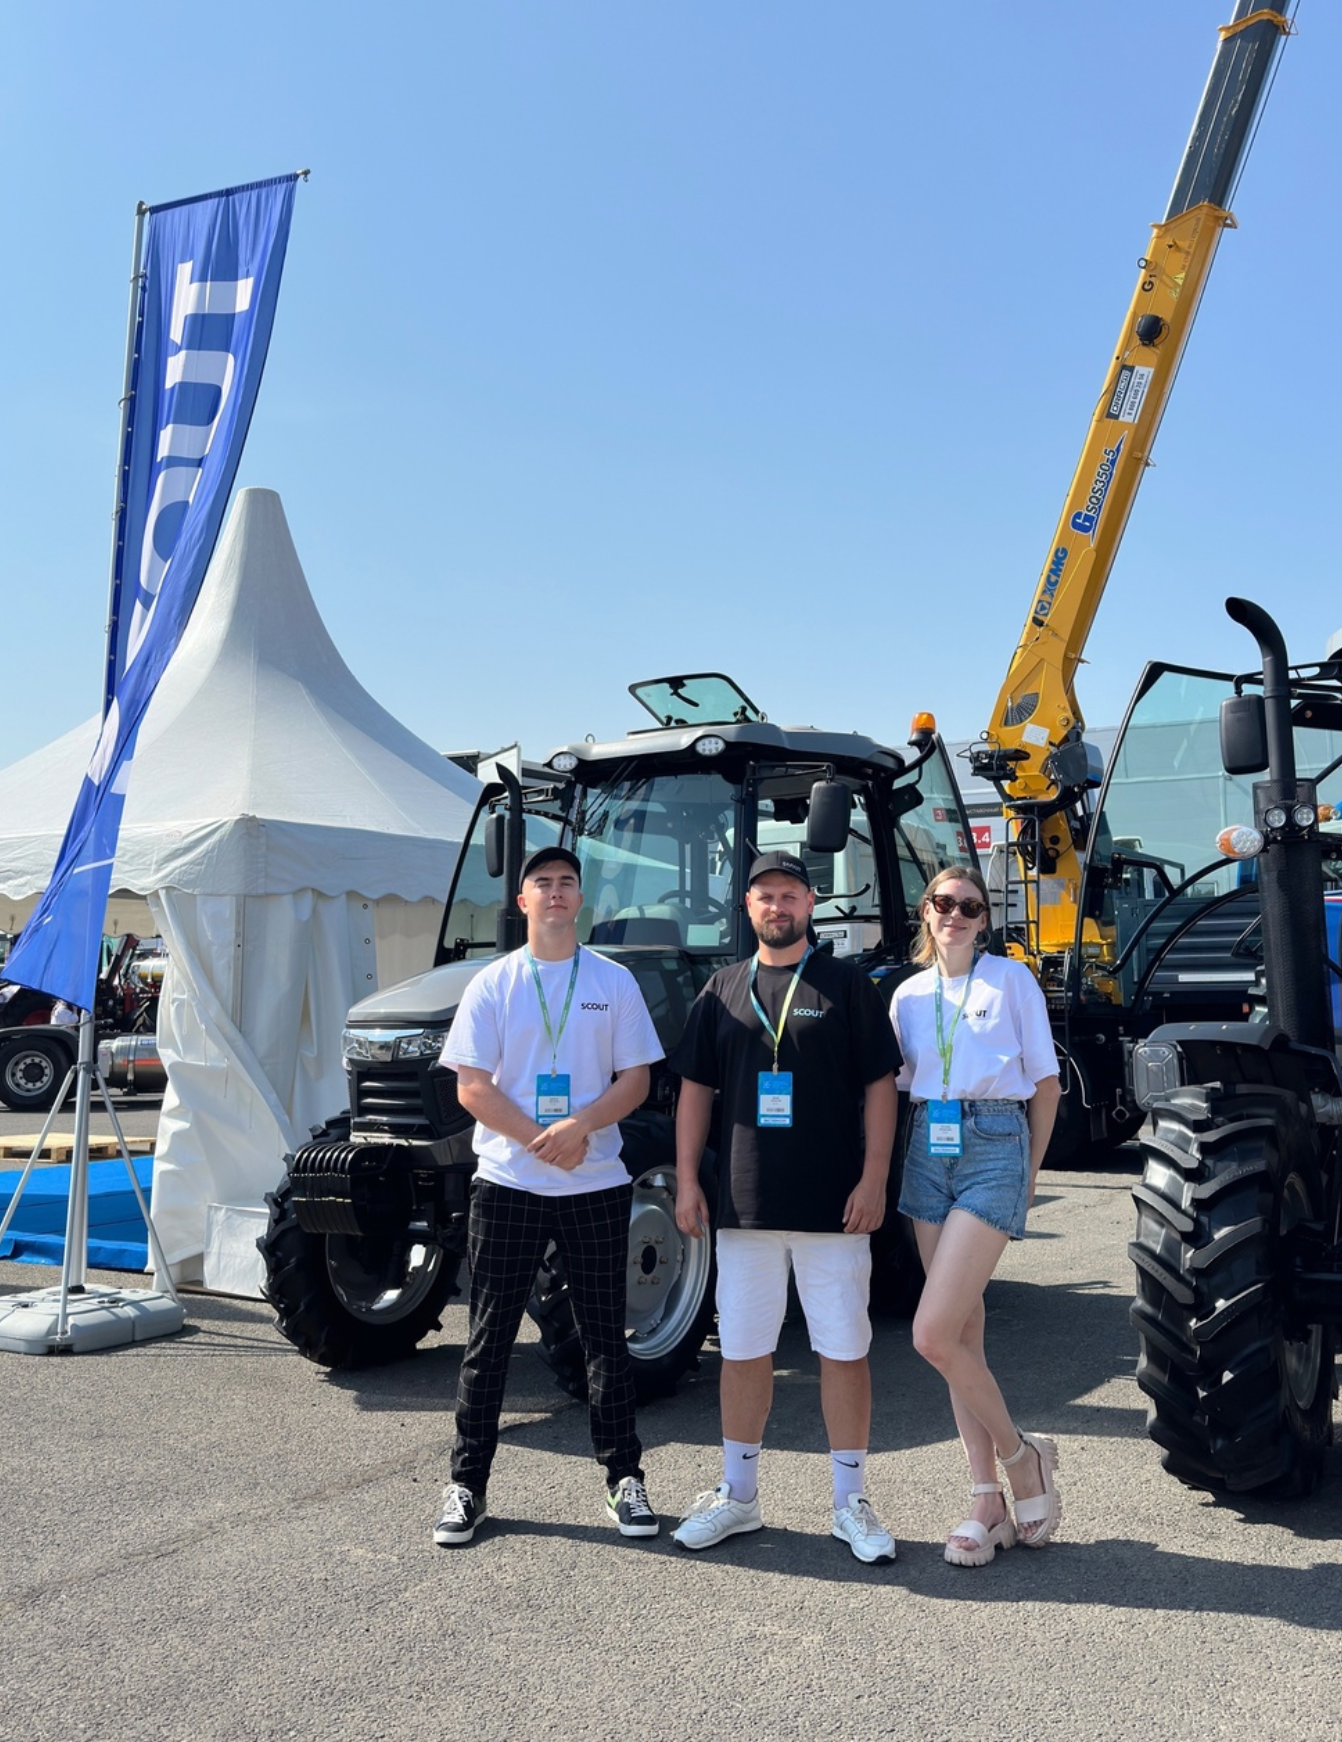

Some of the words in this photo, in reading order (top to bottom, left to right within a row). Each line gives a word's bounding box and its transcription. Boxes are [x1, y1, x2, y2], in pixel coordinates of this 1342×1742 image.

[1042, 547, 1068, 598] XCMG
[581, 1002, 609, 1011] SCOUT
[793, 1008, 824, 1018] SCOUT
